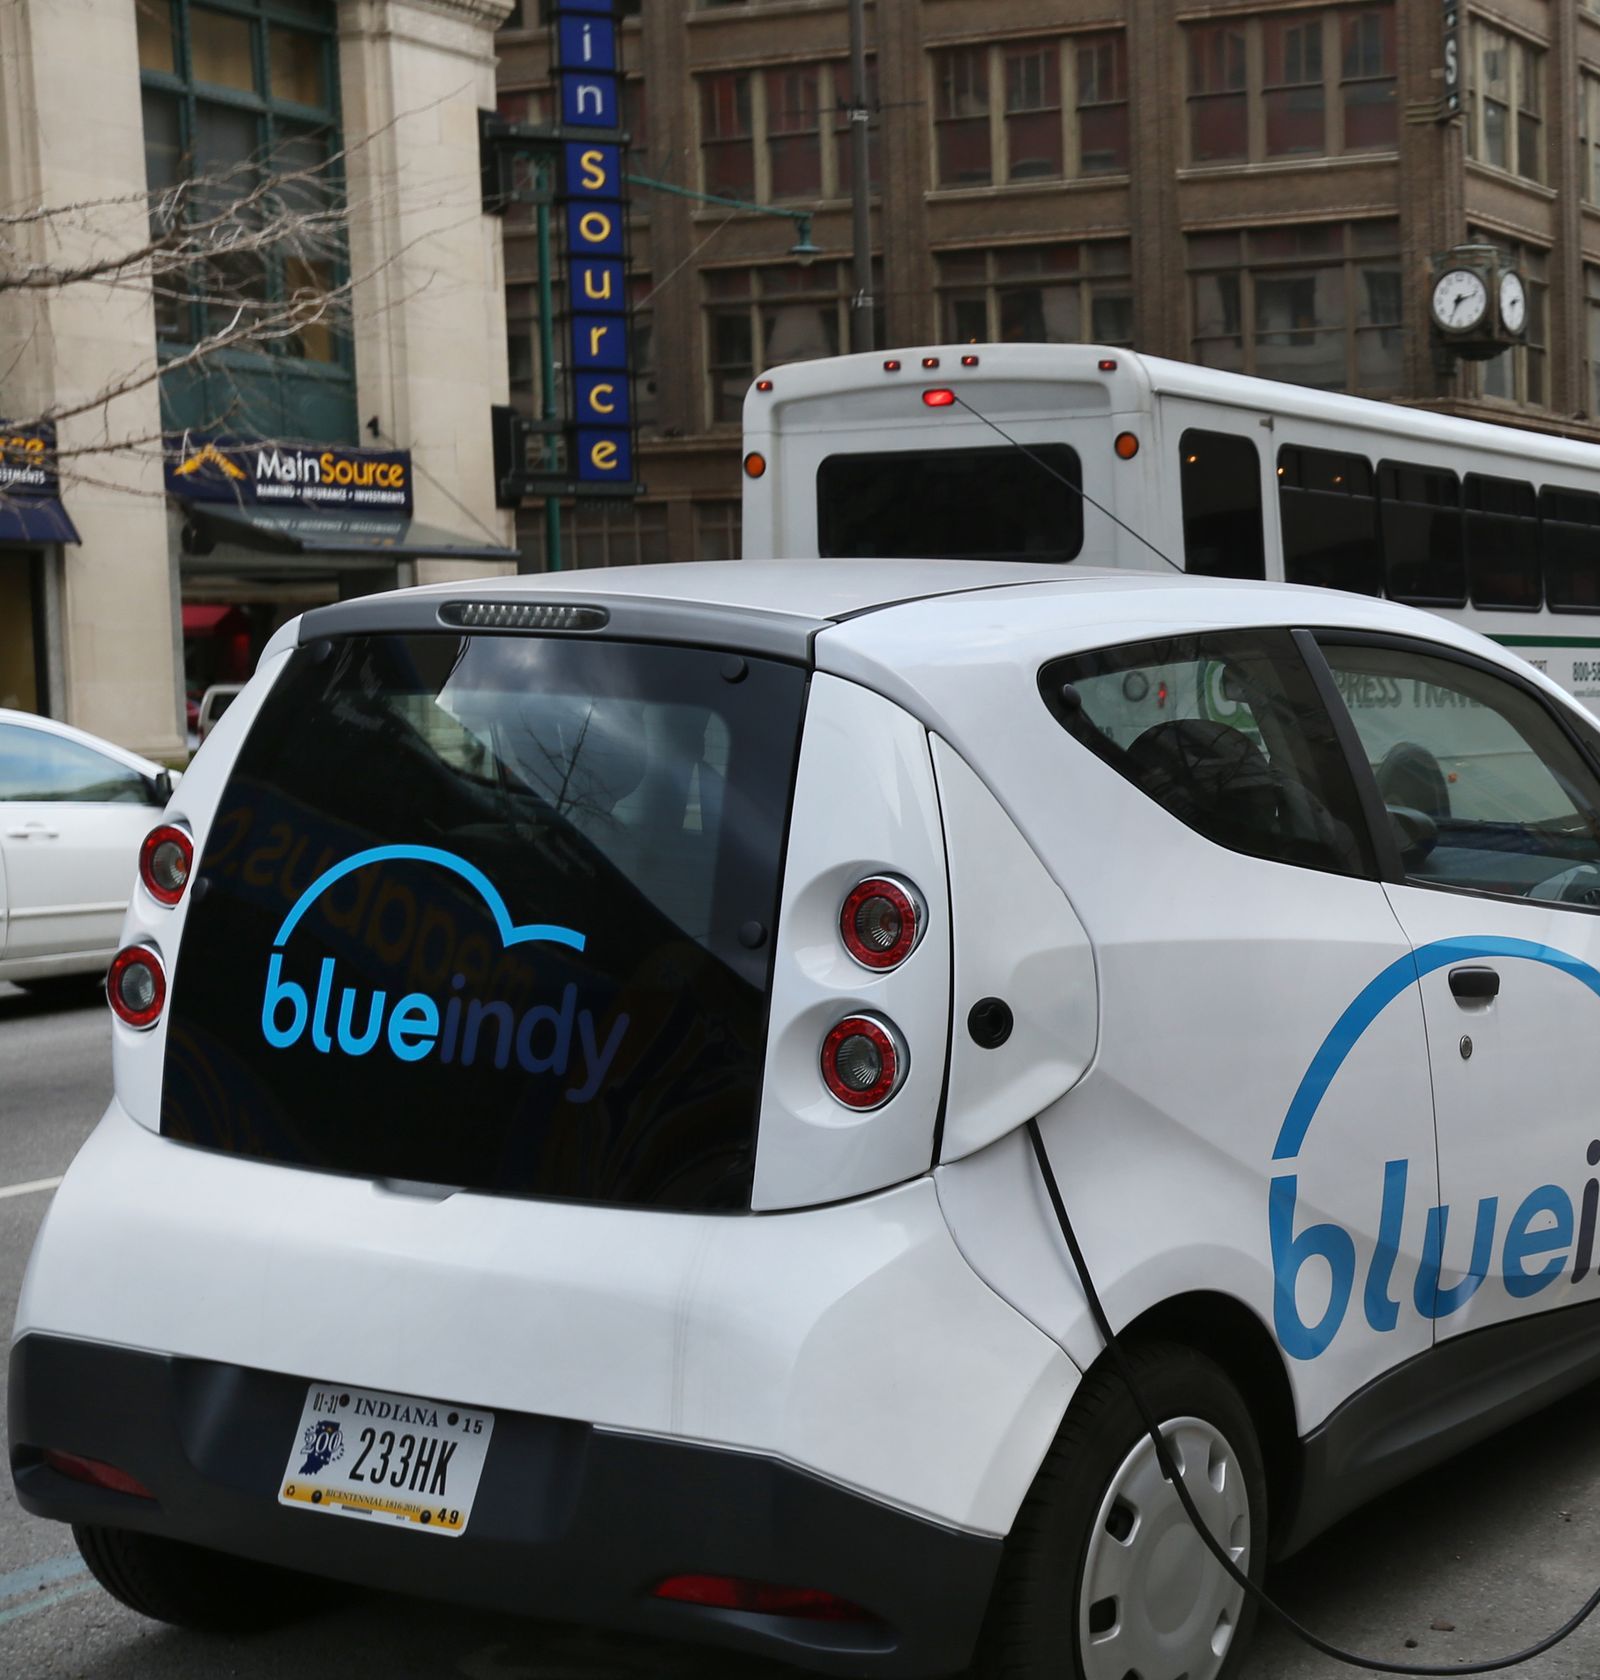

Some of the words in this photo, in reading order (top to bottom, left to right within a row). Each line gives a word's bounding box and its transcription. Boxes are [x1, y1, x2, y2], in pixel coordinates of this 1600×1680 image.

[256, 450, 404, 487] MainSource
[262, 953, 630, 1103] blueindy
[354, 1398, 439, 1428] INDIANA
[462, 1417, 483, 1434] 15
[301, 1428, 343, 1455] 200
[349, 1427, 458, 1497] 233HK
[325, 1488, 384, 1507] BICENTENNIAL
[437, 1507, 460, 1525] 49
